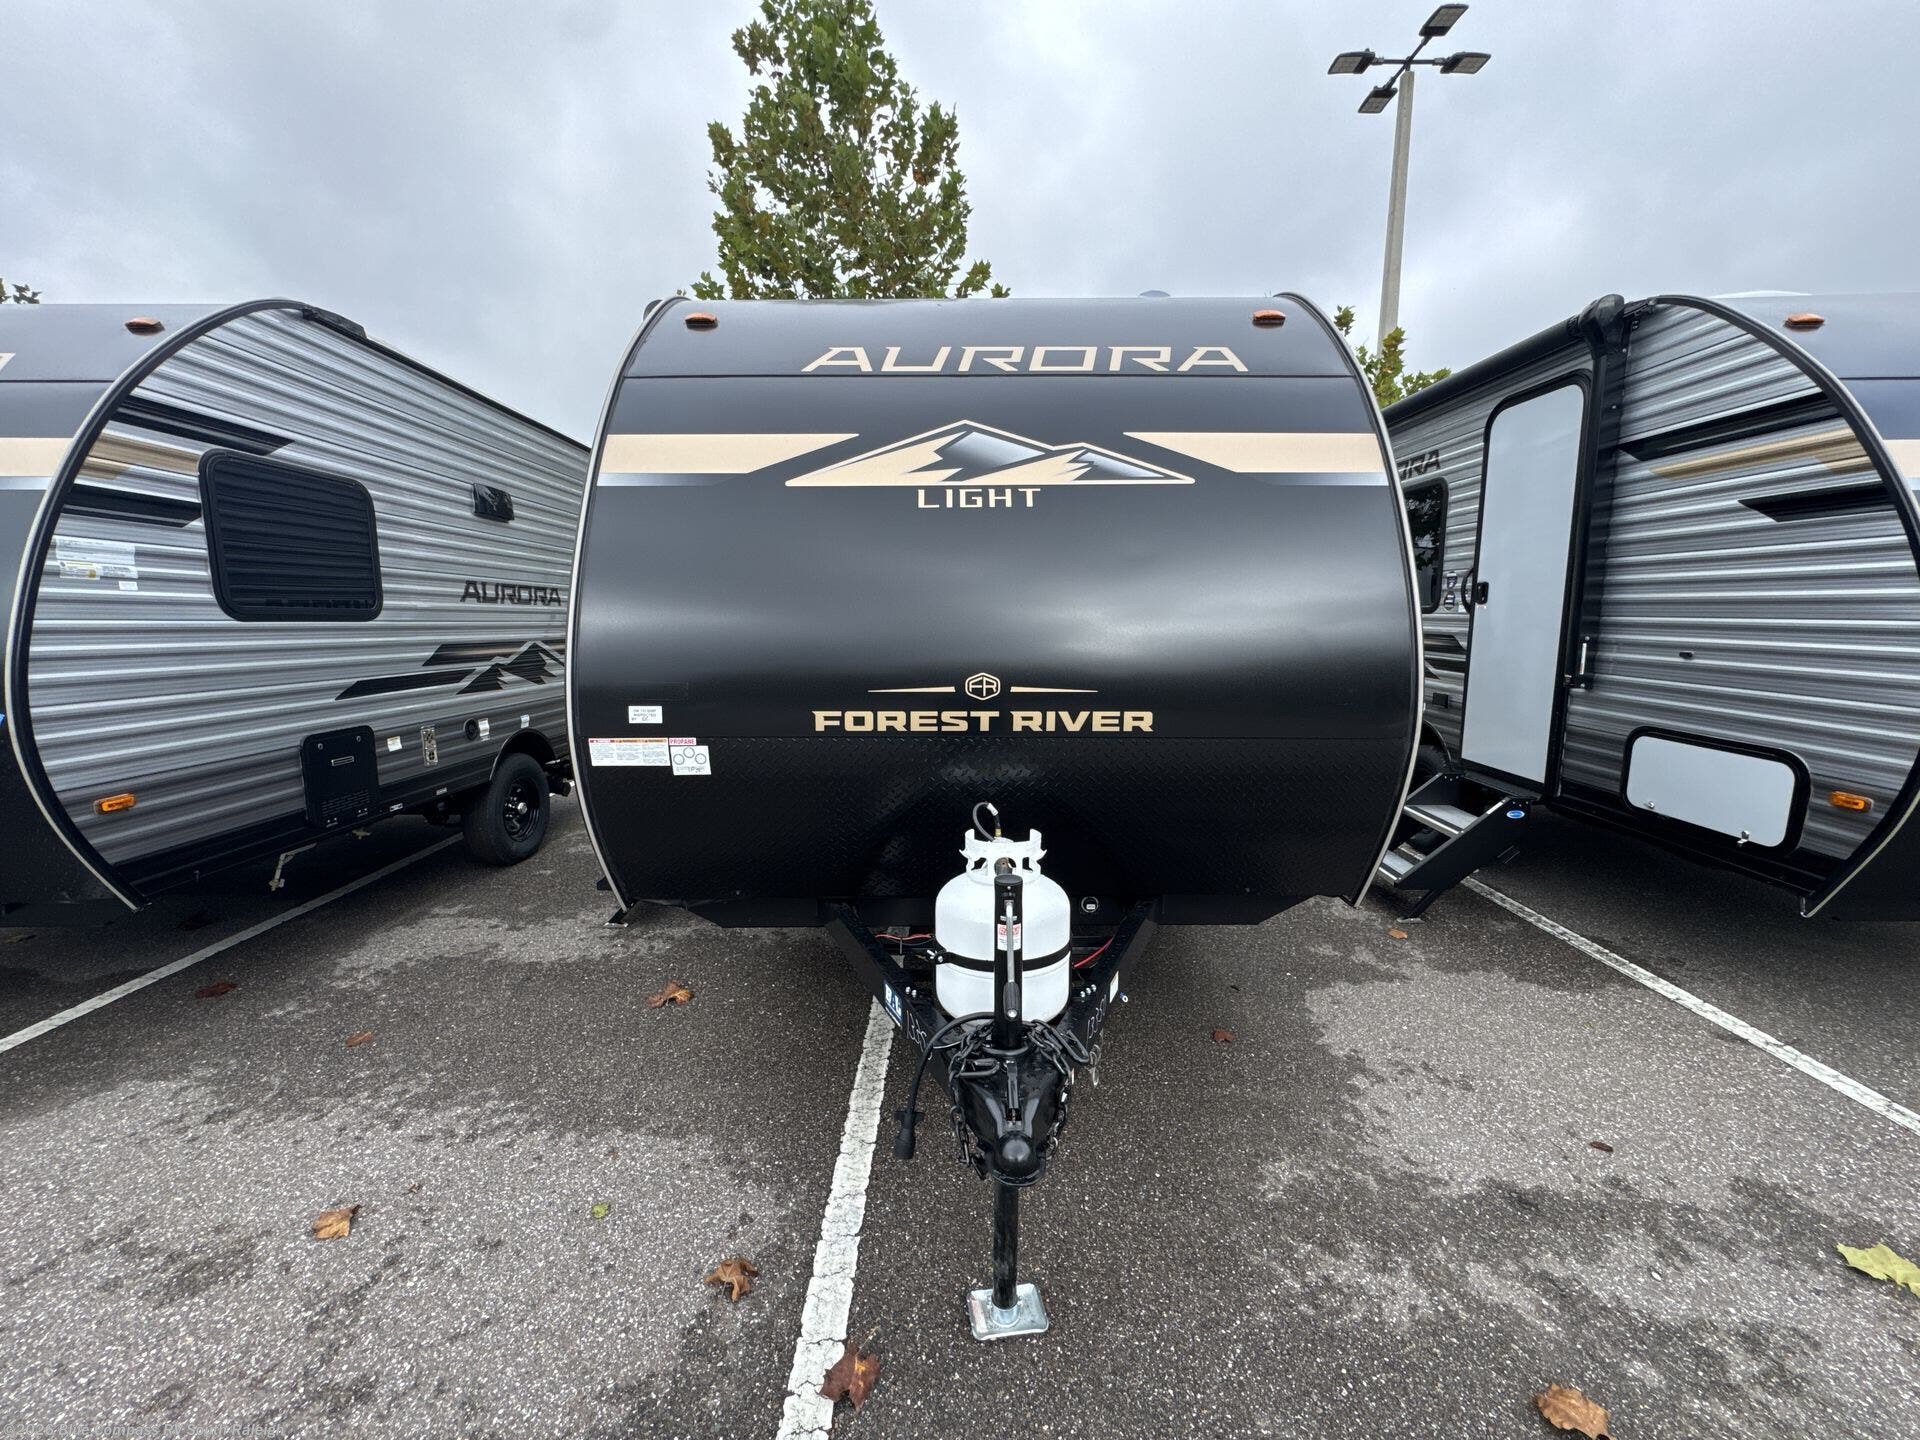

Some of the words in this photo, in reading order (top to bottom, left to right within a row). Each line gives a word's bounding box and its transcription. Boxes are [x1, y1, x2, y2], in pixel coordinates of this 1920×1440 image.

[801, 346, 1249, 372] AURORA
[917, 488, 1041, 509] LIGHT
[460, 580, 562, 606] AURORA
[812, 710, 1000, 732] FOREST
[1009, 710, 1154, 732] RIVER
